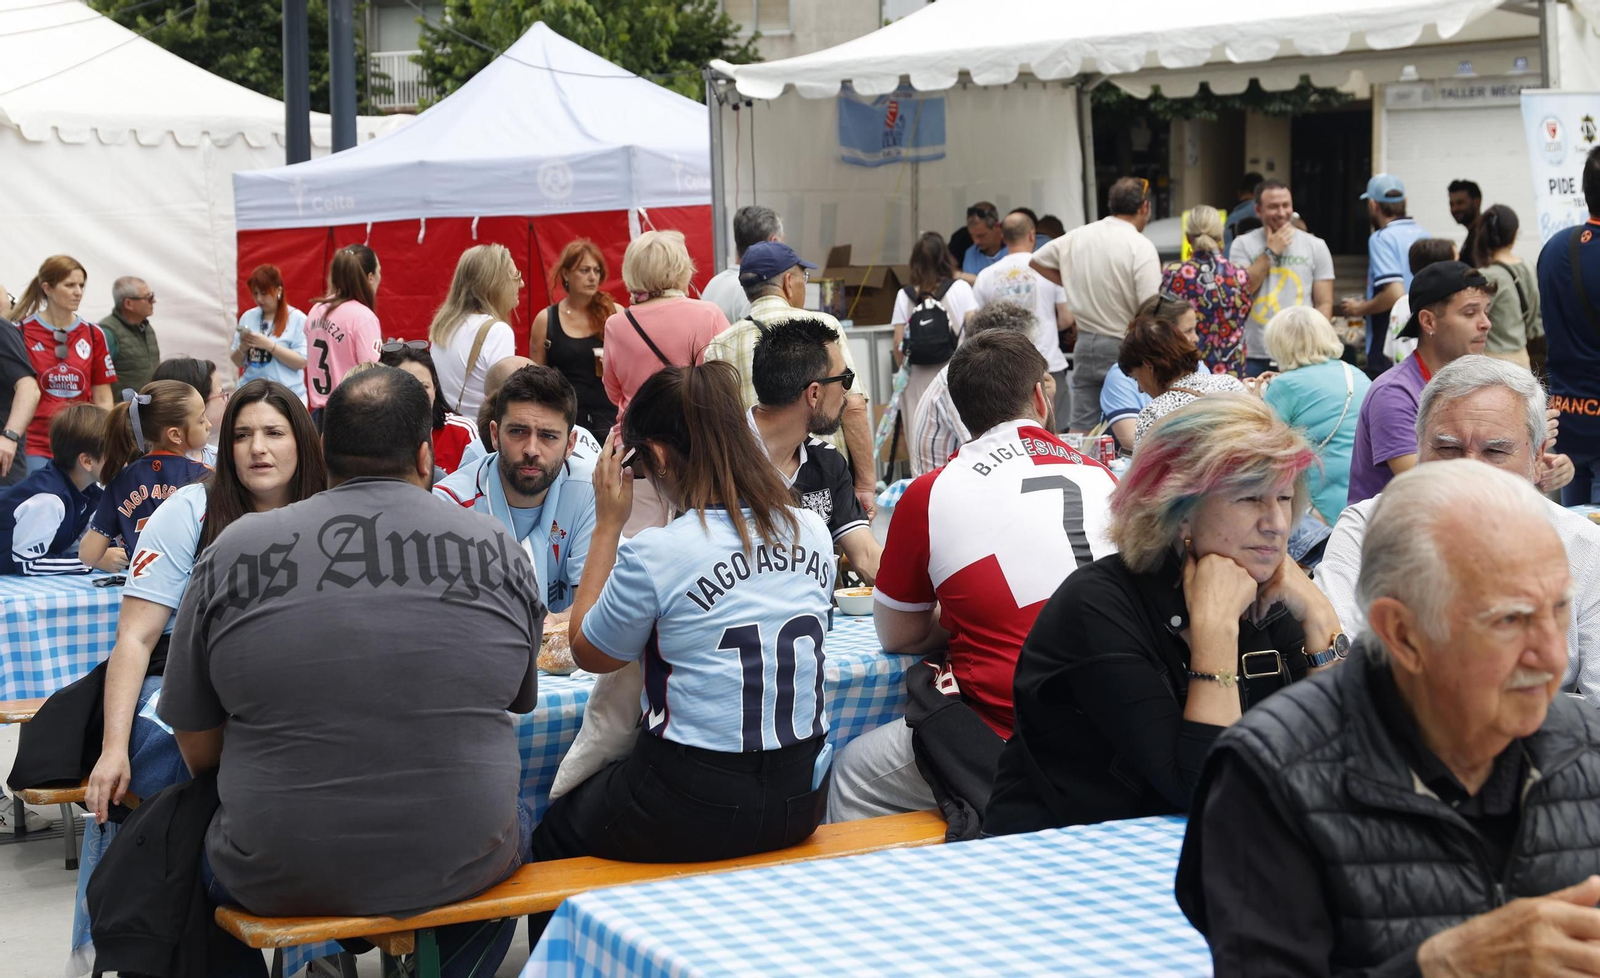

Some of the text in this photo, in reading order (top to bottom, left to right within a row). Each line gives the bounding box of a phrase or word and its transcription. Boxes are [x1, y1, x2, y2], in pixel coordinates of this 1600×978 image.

[1441, 86, 1486, 99] TALLER
[1549, 178, 1576, 195] PIDE
[311, 195, 355, 211] Celta
[48, 373, 80, 382] Estrella
[312, 338, 332, 395] 3
[49, 381, 78, 390] Galicia
[1548, 394, 1600, 417] ABANC
[117, 485, 149, 518] IAGO
[1020, 475, 1094, 570] 7
[685, 542, 830, 613] IAGO ASPAS
[715, 613, 826, 753] 10
